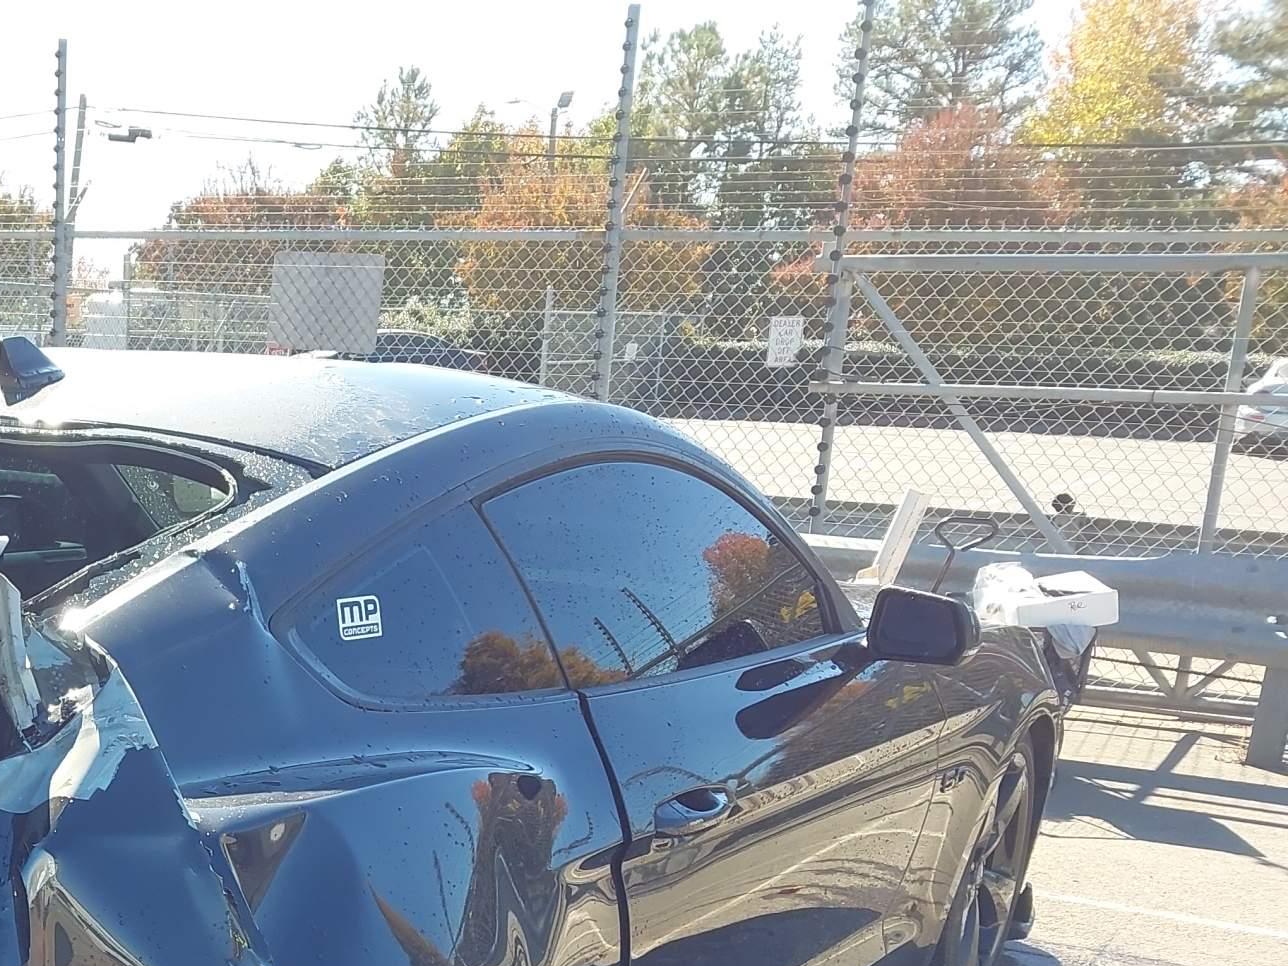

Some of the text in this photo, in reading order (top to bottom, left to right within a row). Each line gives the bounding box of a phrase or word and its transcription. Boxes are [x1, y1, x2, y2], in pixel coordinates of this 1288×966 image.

[773, 319, 801, 327] DEALER
[340, 599, 378, 624] MP
[343, 625, 379, 636] CONCEPTS
